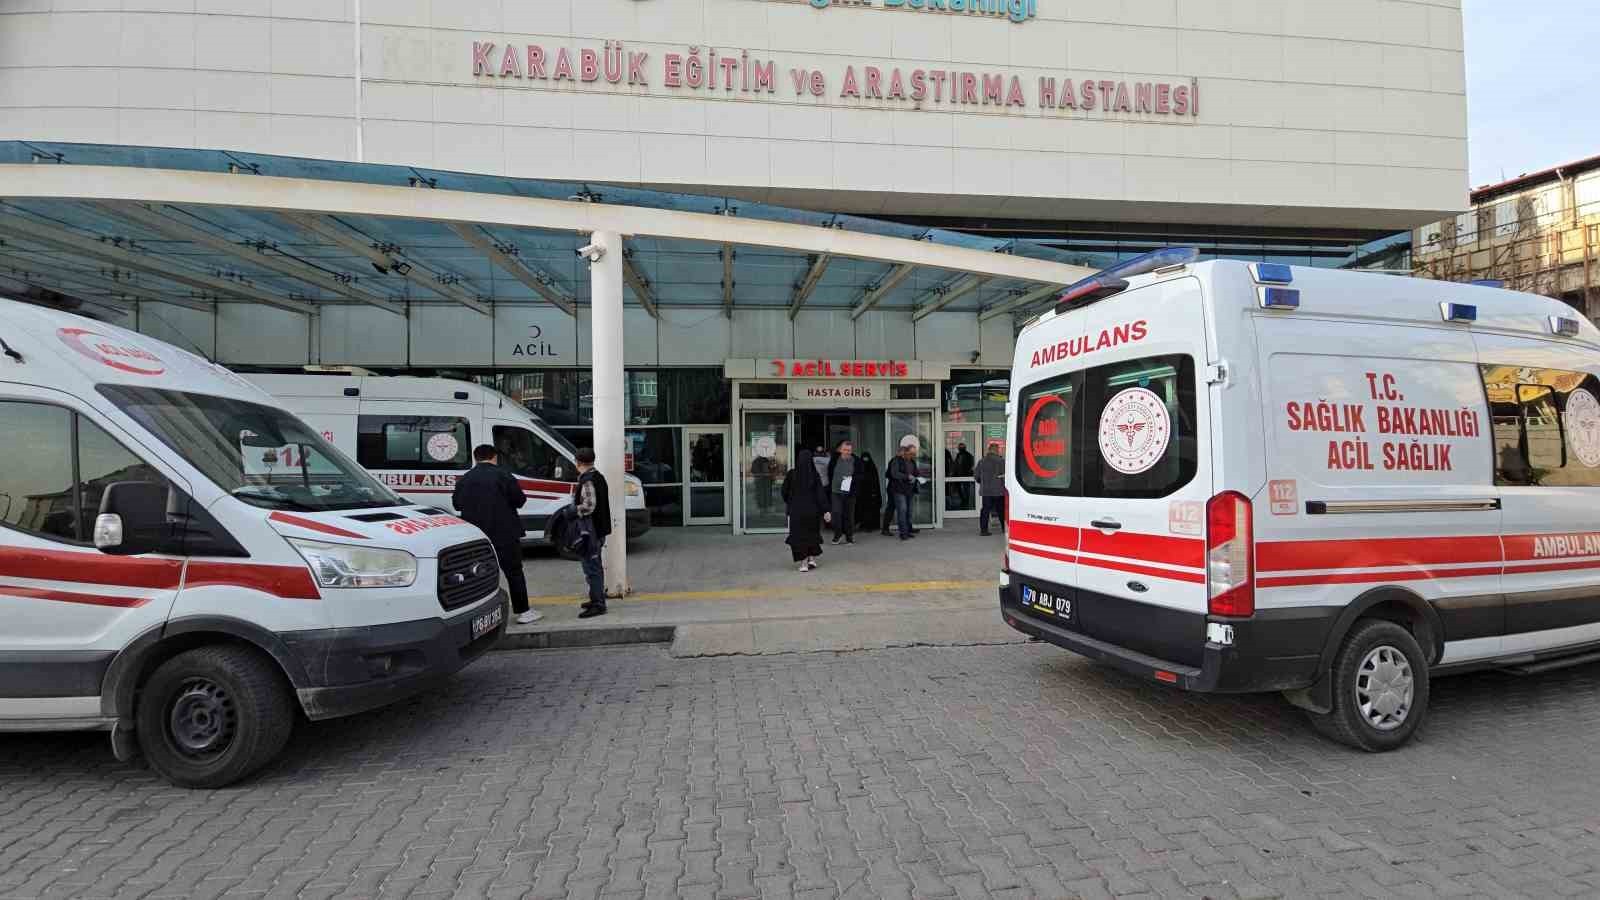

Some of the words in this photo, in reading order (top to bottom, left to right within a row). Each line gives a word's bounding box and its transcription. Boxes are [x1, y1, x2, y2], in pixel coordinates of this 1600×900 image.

[472, 40, 649, 86] KARABÜK
[664, 46, 775, 93] EĞİTİM
[790, 68, 825, 96] ve
[840, 65, 1026, 111] ARAŞTIRMA
[1038, 76, 1200, 117] HASTANESİ
[512, 341, 558, 356] ACİL
[1030, 320, 1148, 368] AMBULANS
[792, 360, 835, 377] ACİL
[840, 360, 909, 377] SERVİS
[807, 388, 841, 397] HASTA
[1365, 372, 1404, 401] T.C.
[1286, 398, 1366, 433] SAĞLIK
[1377, 405, 1480, 437] BAKANLIĞI
[1327, 436, 1374, 470] ACİL
[1383, 439, 1452, 470] SAĞLIK
[1039, 593, 1053, 608] ABJ
[1056, 598, 1071, 614] 079
